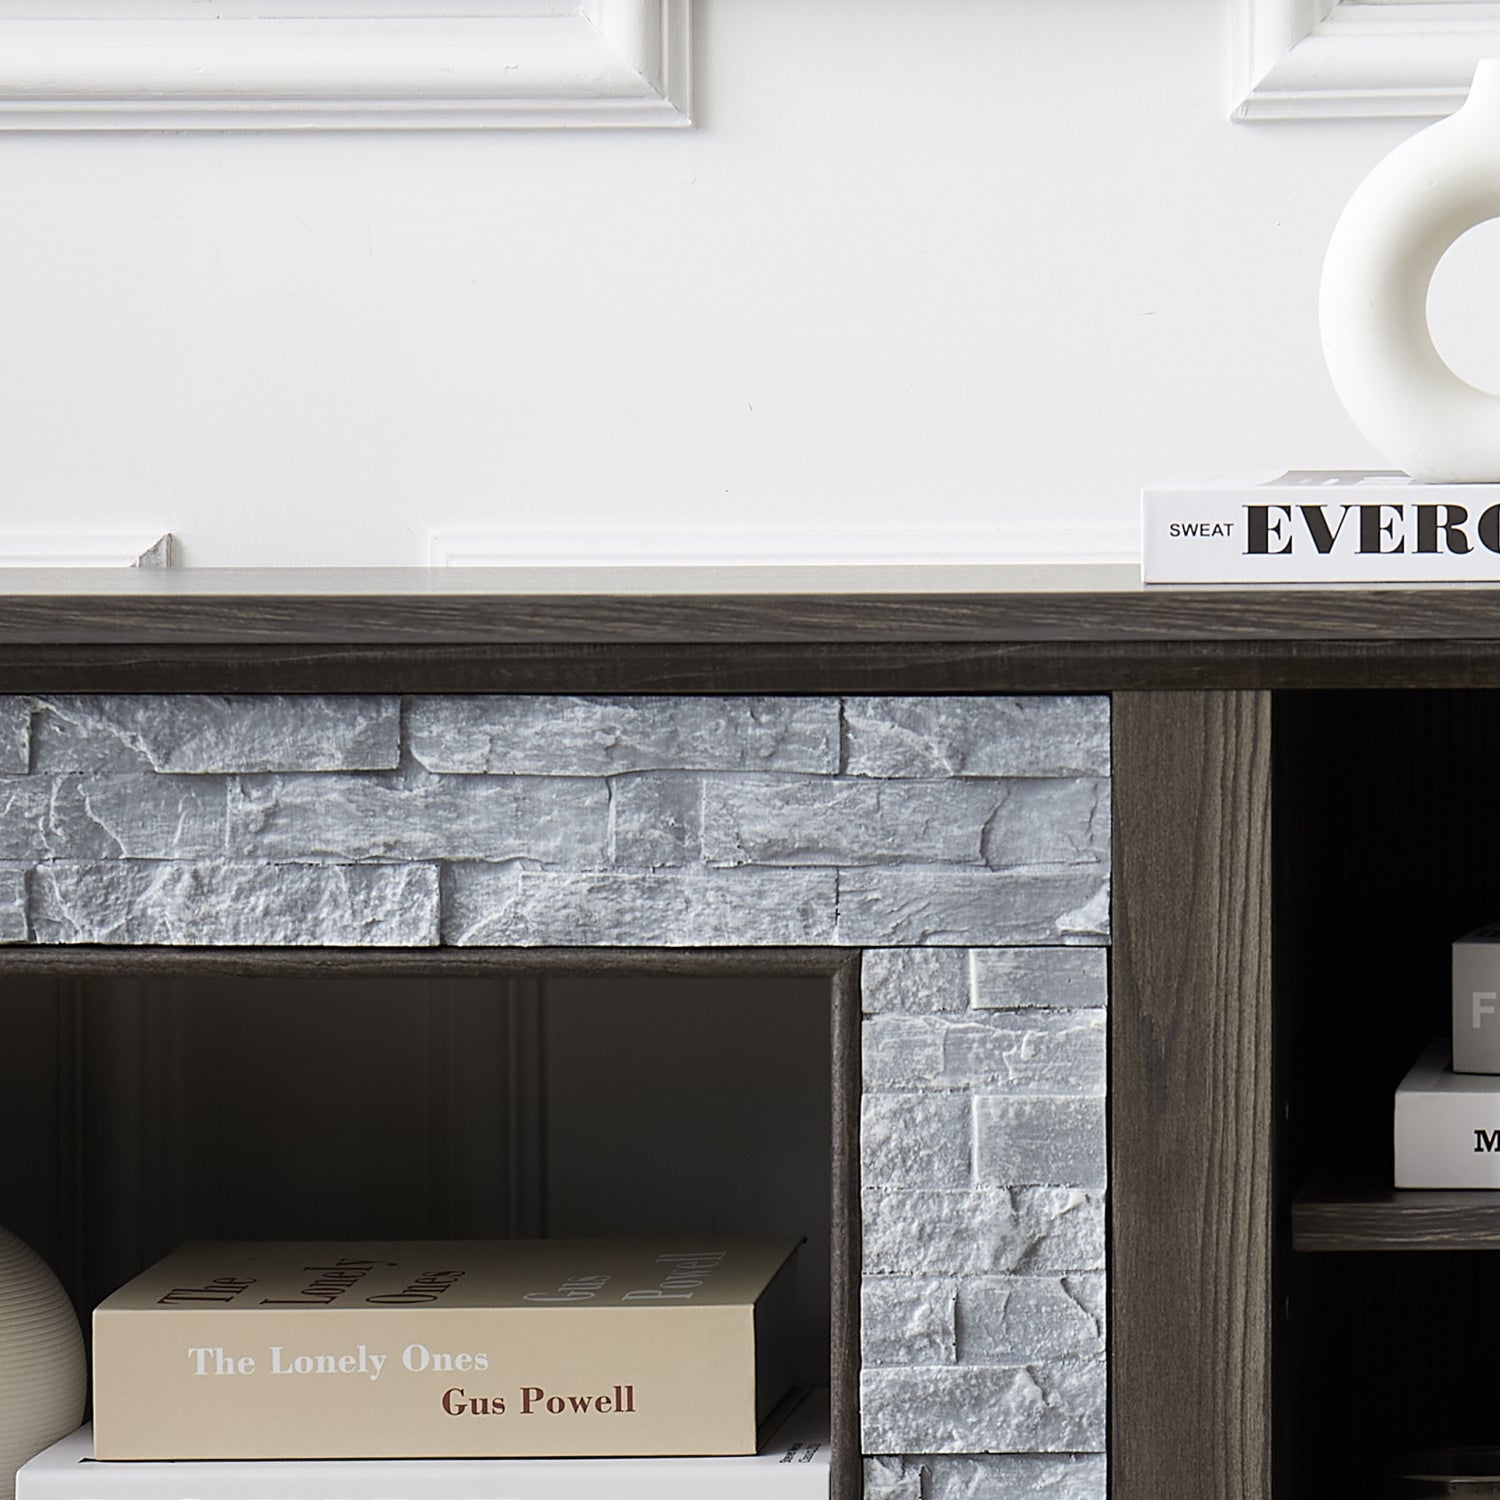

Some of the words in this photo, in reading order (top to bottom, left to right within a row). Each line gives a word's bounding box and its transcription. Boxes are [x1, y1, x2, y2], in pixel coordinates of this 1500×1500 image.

[1169, 522, 1235, 538] SWEAT
[157, 1275, 258, 1306] The
[259, 1257, 399, 1306] Lonely
[365, 1269, 467, 1305] Ones
[522, 1274, 612, 1302] Gus
[621, 1250, 729, 1302] Powell
[188, 1347, 256, 1376] The
[270, 1346, 387, 1381] Lonely
[402, 1344, 489, 1373] Ones
[441, 1387, 506, 1417] Gus
[519, 1385, 636, 1415] Powell
